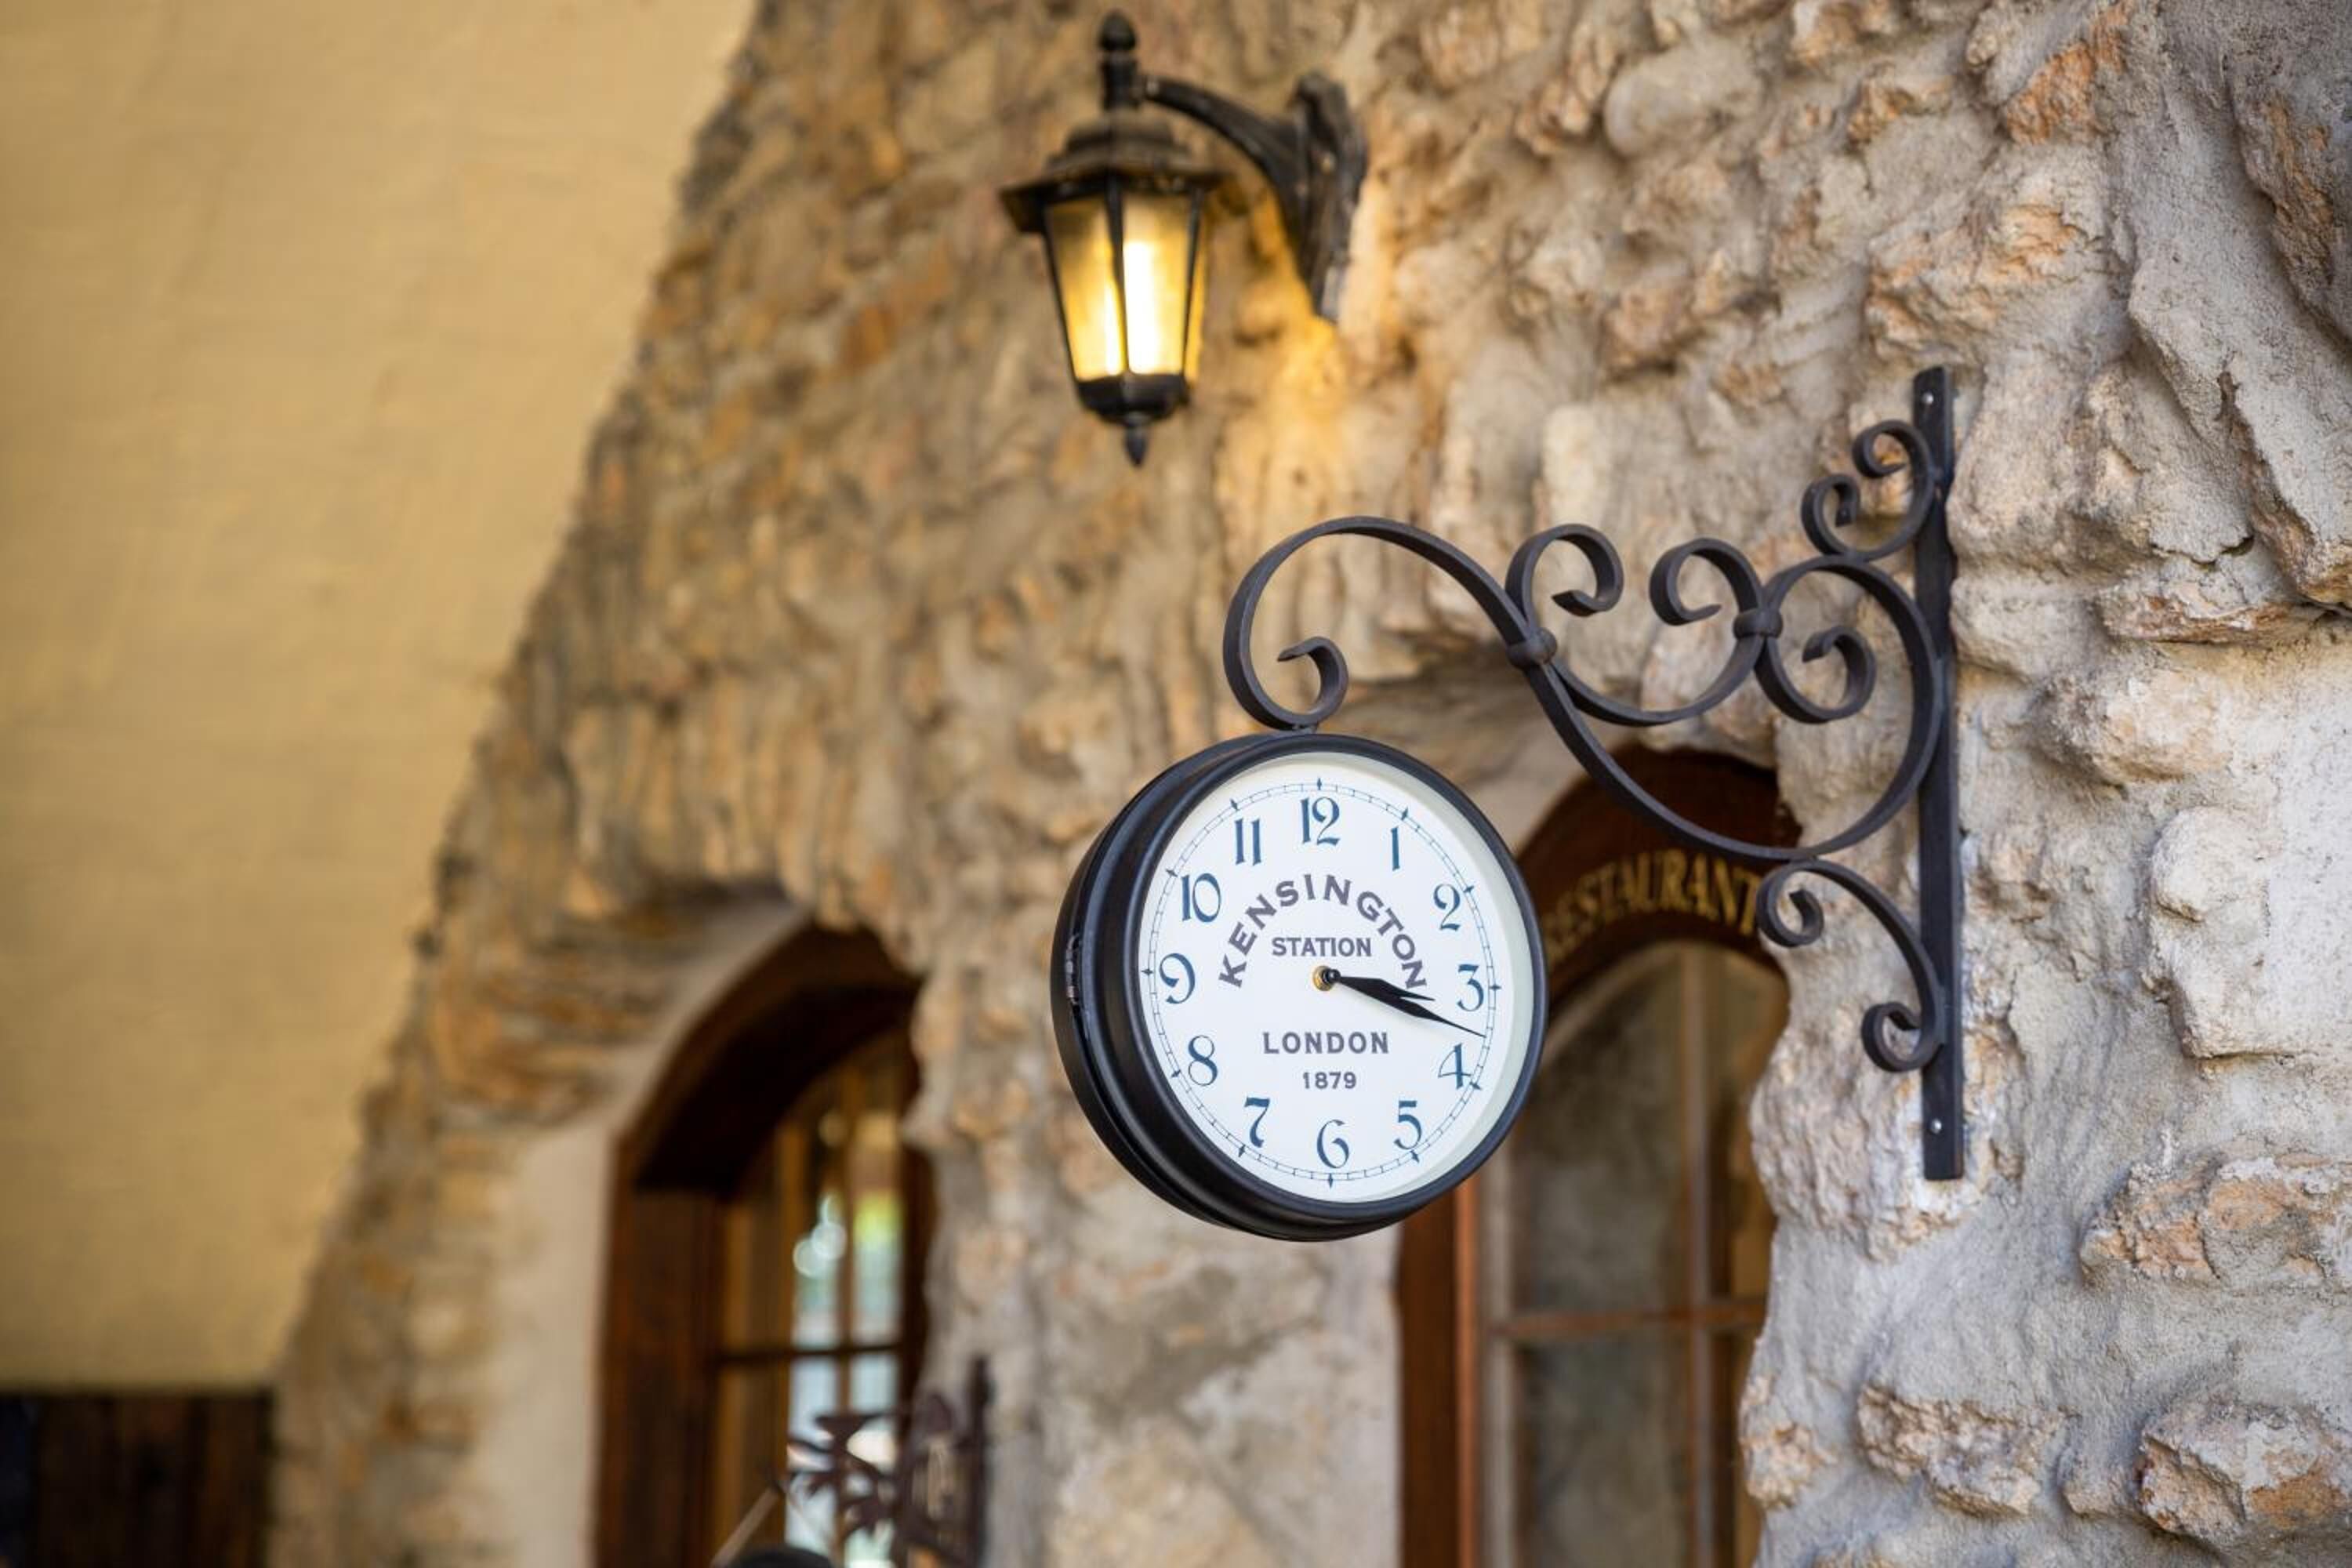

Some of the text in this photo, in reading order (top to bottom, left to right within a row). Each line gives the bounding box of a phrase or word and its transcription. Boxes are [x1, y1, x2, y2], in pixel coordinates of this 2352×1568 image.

[1235, 818, 1262, 866] 11
[1301, 797, 1341, 847] 12
[1390, 826, 1401, 872] 1
[1181, 873, 1221, 924] 10
[1433, 884, 1462, 932] 2
[1218, 873, 1428, 990] KENSINGTON
[1272, 937, 1373, 957] STATION
[1158, 953, 1196, 1005] 9
[1456, 964, 1486, 1012] 3
[1187, 1035, 1218, 1087] 8
[1262, 1032, 1389, 1054] LONDON
[1437, 1043, 1473, 1091] 4
[1302, 1071, 1357, 1090] 1879
[1243, 1096, 1272, 1149] 7
[1316, 1119, 1351, 1169] 6
[1393, 1099, 1424, 1151] 5
